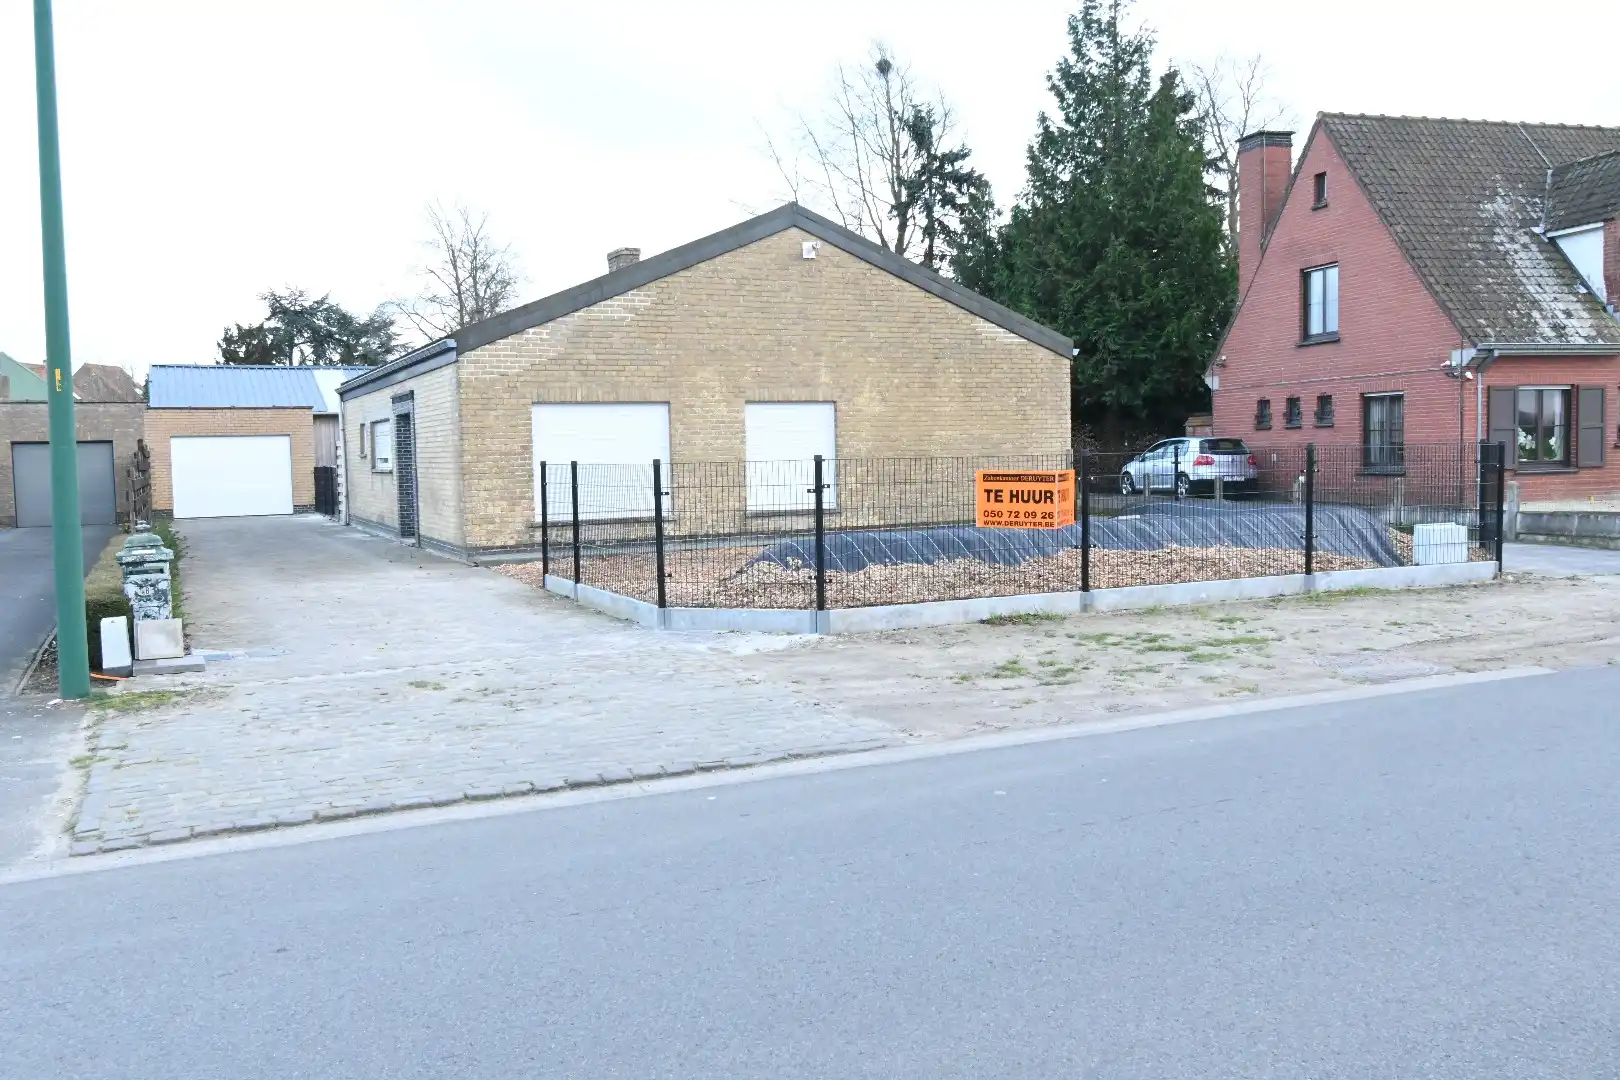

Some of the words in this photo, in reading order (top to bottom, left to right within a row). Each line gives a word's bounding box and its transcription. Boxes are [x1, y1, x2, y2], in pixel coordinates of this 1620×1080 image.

[983, 489, 1004, 503] TE
[1009, 489, 1054, 504] HUUR
[983, 510, 1004, 518] 050
[1023, 511, 1037, 519] 09
[1040, 511, 1054, 519] 26
[983, 520, 1055, 528] WWW.DERUYTER.BE
